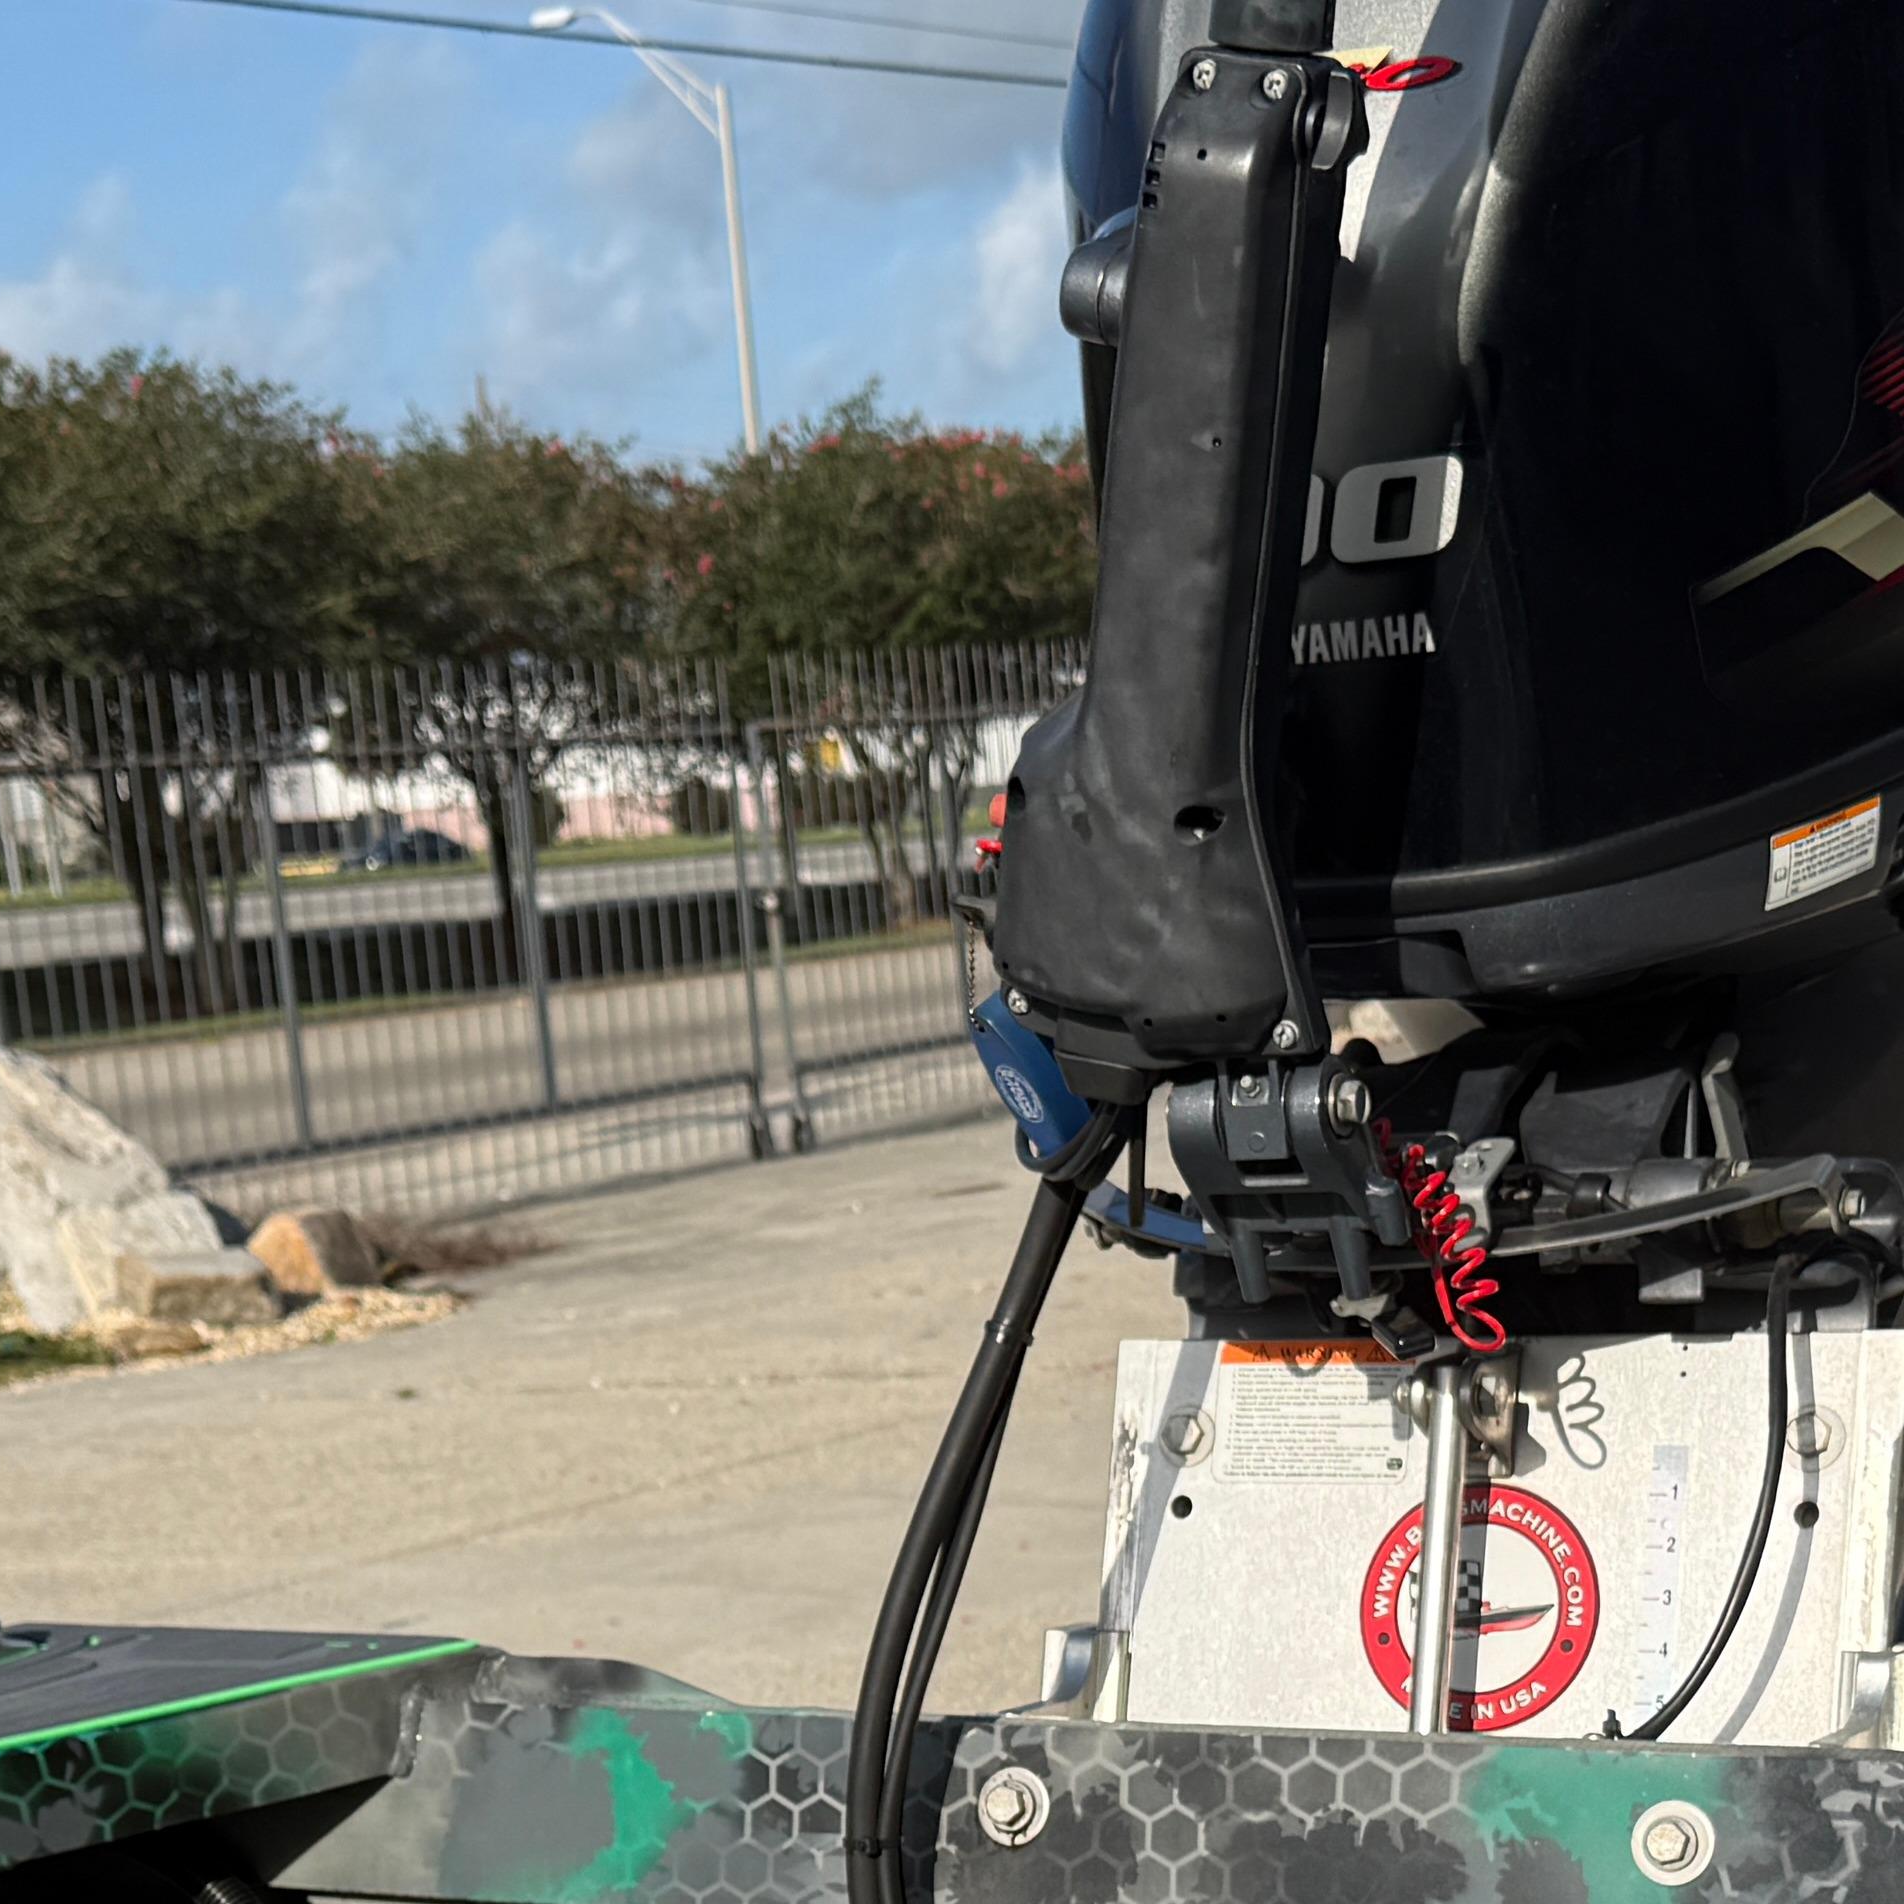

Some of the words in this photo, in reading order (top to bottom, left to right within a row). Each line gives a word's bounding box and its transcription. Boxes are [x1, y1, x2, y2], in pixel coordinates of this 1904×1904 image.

[1291, 612, 1436, 665] YAMAHA
[1671, 1484, 1681, 1500] 1
[1666, 1537, 1677, 1553] 2
[1662, 1590, 1672, 1605] 3
[1658, 1642, 1669, 1658] 4
[1499, 1681, 1549, 1714] USA
[1654, 1694, 1666, 1712] 5
